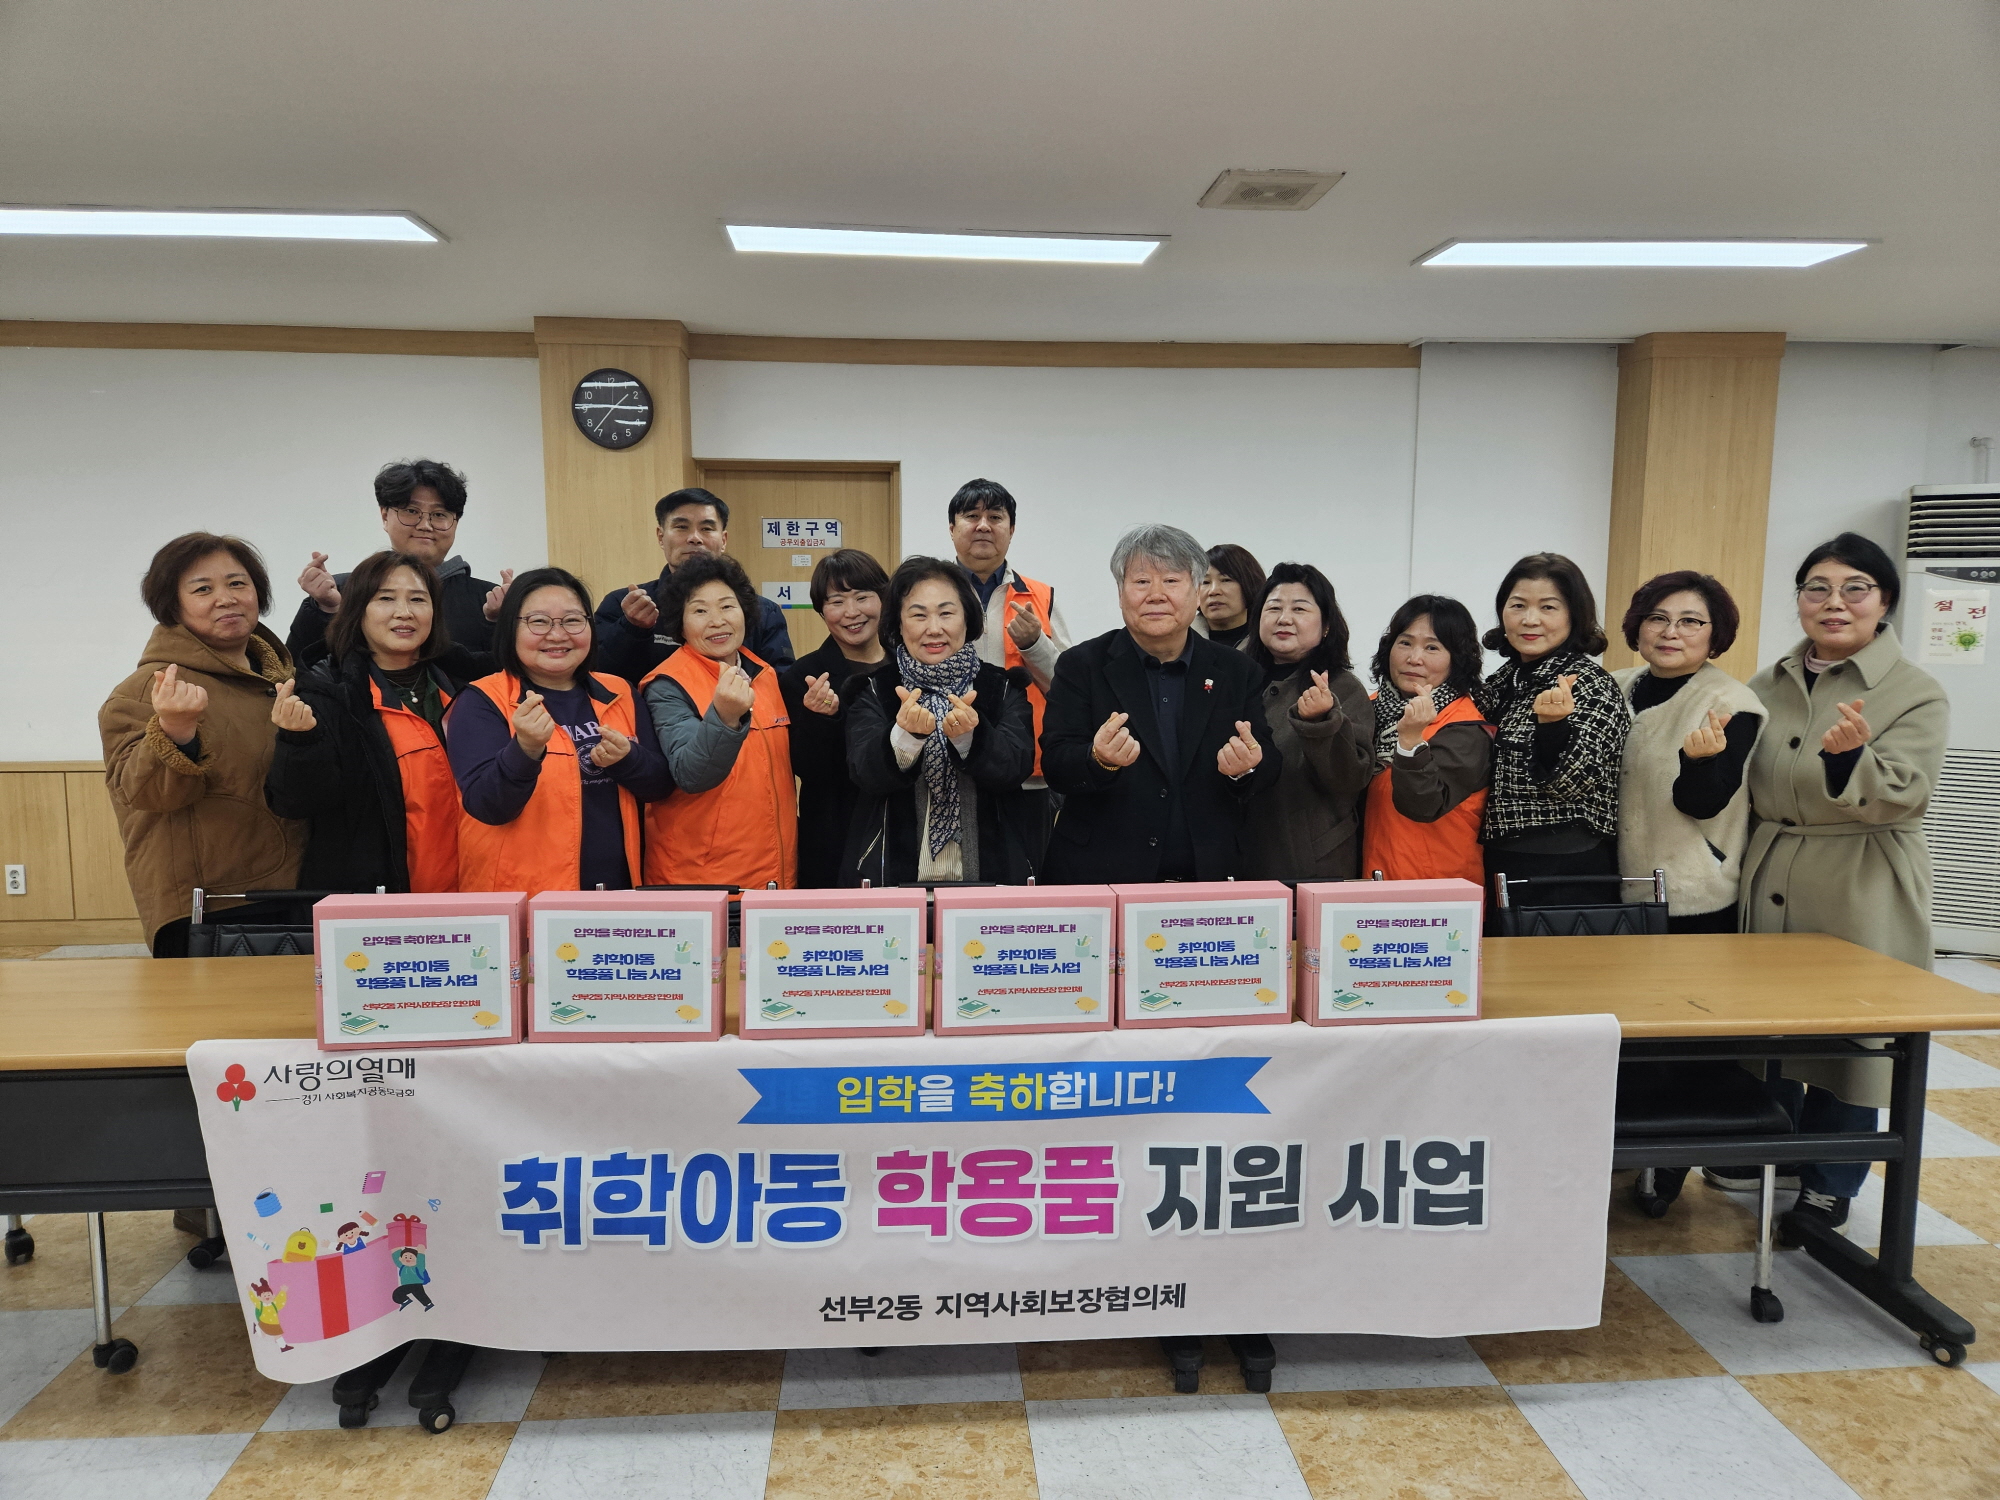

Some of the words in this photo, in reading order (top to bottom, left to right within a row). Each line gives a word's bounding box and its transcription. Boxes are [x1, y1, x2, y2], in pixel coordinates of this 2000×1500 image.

[584, 391, 593, 400] 10
[633, 391, 639, 400] 2
[587, 419, 593, 427] 8
[598, 429, 604, 437] 7
[612, 433, 618, 441] 6
[626, 429, 632, 437] 5
[767, 520, 838, 536] 제한구역
[777, 585, 791, 600] 서
[979, 924, 1015, 935] 입학을
[1016, 923, 1077, 935] 축하합니다!
[1160, 917, 1195, 929] 입학을
[1196, 915, 1255, 928] 축하합니다!
[1356, 918, 1390, 929] 입학을
[1391, 917, 1448, 928] 축하합니다!
[573, 927, 611, 939] 입학을
[612, 927, 676, 939] 축하합니다!
[784, 925, 821, 936] 입학을
[822, 924, 885, 935] 축하합니다!
[362, 935, 402, 947] 입학을
[403, 933, 472, 945] 축하합니다!
[1177, 940, 1236, 955] 취학아동
[1372, 941, 1430, 955] 취학아동
[591, 953, 656, 966] 취학아동
[802, 949, 864, 963] 취학아동
[997, 948, 1057, 962] 취학아동
[1154, 956, 1198, 969] 학용품
[1199, 955, 1229, 968] 나눔
[1230, 954, 1260, 967] 사업
[383, 959, 451, 975] 취학아동
[972, 963, 1018, 977] 학용품
[1019, 962, 1049, 975] 나눔
[1050, 961, 1081, 975] 사업
[1348, 956, 1392, 970] 학용품
[1393, 956, 1422, 970] 나눔
[1423, 955, 1452, 969] 사업
[565, 967, 615, 981] 학용품
[616, 967, 648, 981] 나눔
[649, 968, 682, 981] 사업
[776, 964, 824, 978] 학용품
[825, 964, 857, 977] 나눔
[858, 963, 889, 977] 사업
[356, 976, 407, 990] 학용품
[408, 975, 443, 989] 나눔
[444, 973, 478, 988] 사업
[263, 1057, 416, 1092] 사랑의열매
[302, 1093, 322, 1106] 경기
[324, 1086, 415, 1101] 사회복지공동모금회
[836, 1074, 955, 1114] 입학을
[968, 1070, 1177, 1112] 축하합니다!
[500, 1150, 847, 1247] 취학아동
[875, 1145, 1120, 1238] 학용품
[1145, 1142, 1304, 1232] 지원
[1327, 1138, 1486, 1228] 사업
[818, 1293, 923, 1323] 선부2동
[934, 1282, 1187, 1319] 지역사회보장협의체
